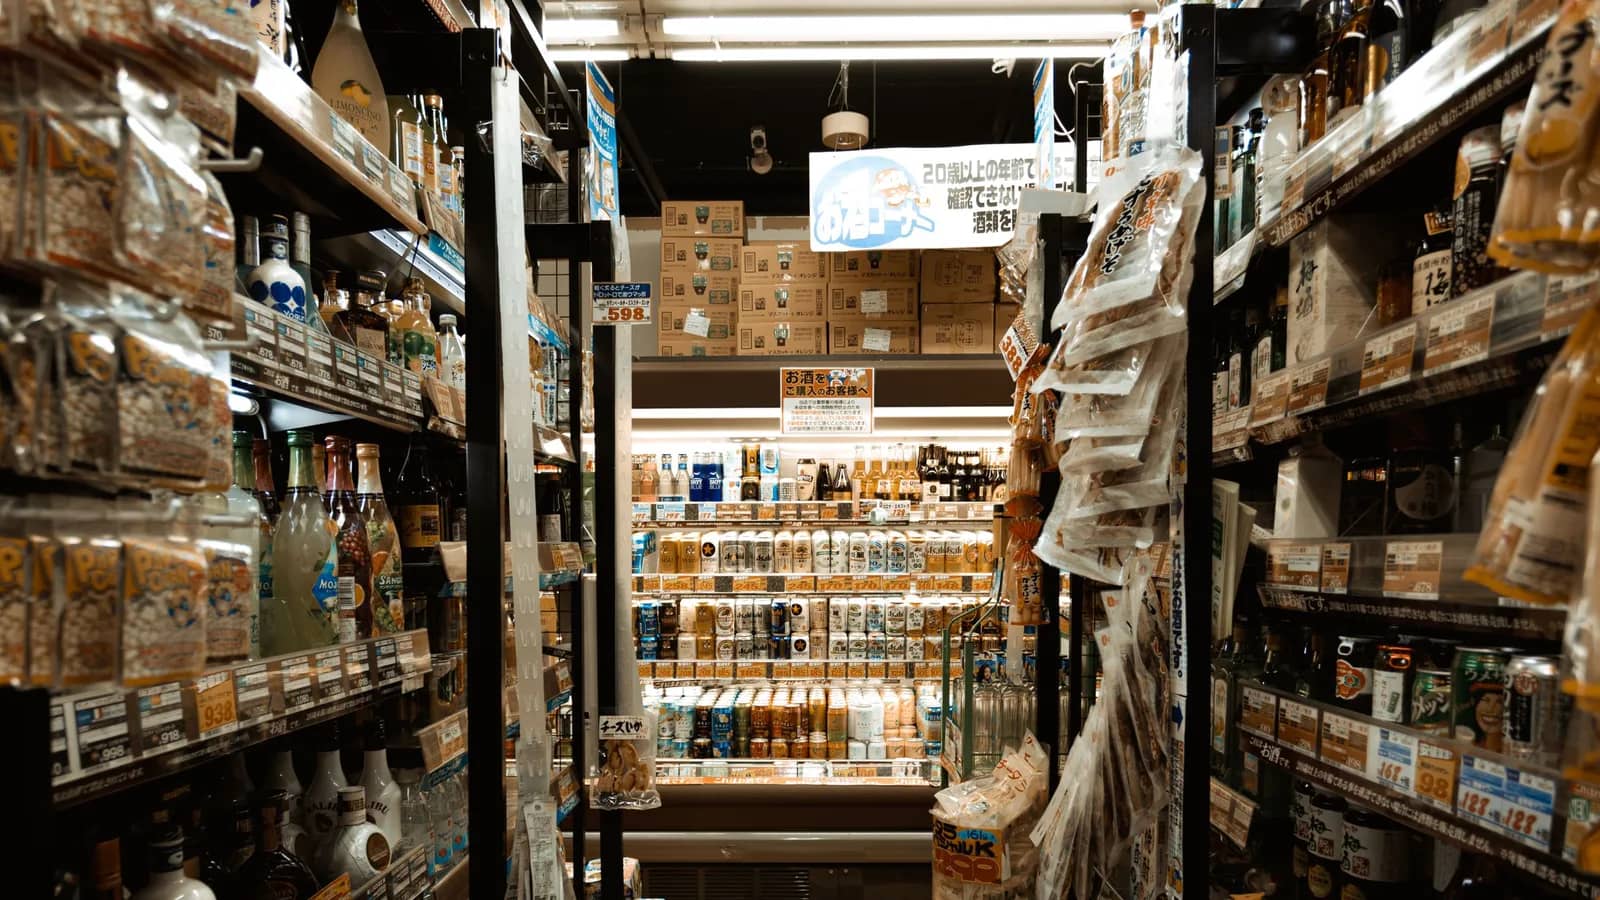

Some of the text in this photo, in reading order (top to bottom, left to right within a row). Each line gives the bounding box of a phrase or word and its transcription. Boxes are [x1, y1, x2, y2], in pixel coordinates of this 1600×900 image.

[608, 307, 645, 321] 598
[1000, 333, 1024, 377] 388
[785, 370, 826, 384] お酒を
[785, 385, 869, 396] ご購入のお客様へ
[203, 700, 233, 728] 938
[600, 720, 643, 733] チーズいか
[160, 730, 180, 746] 918
[101, 745, 125, 762] 998
[1420, 772, 1450, 800] 98
